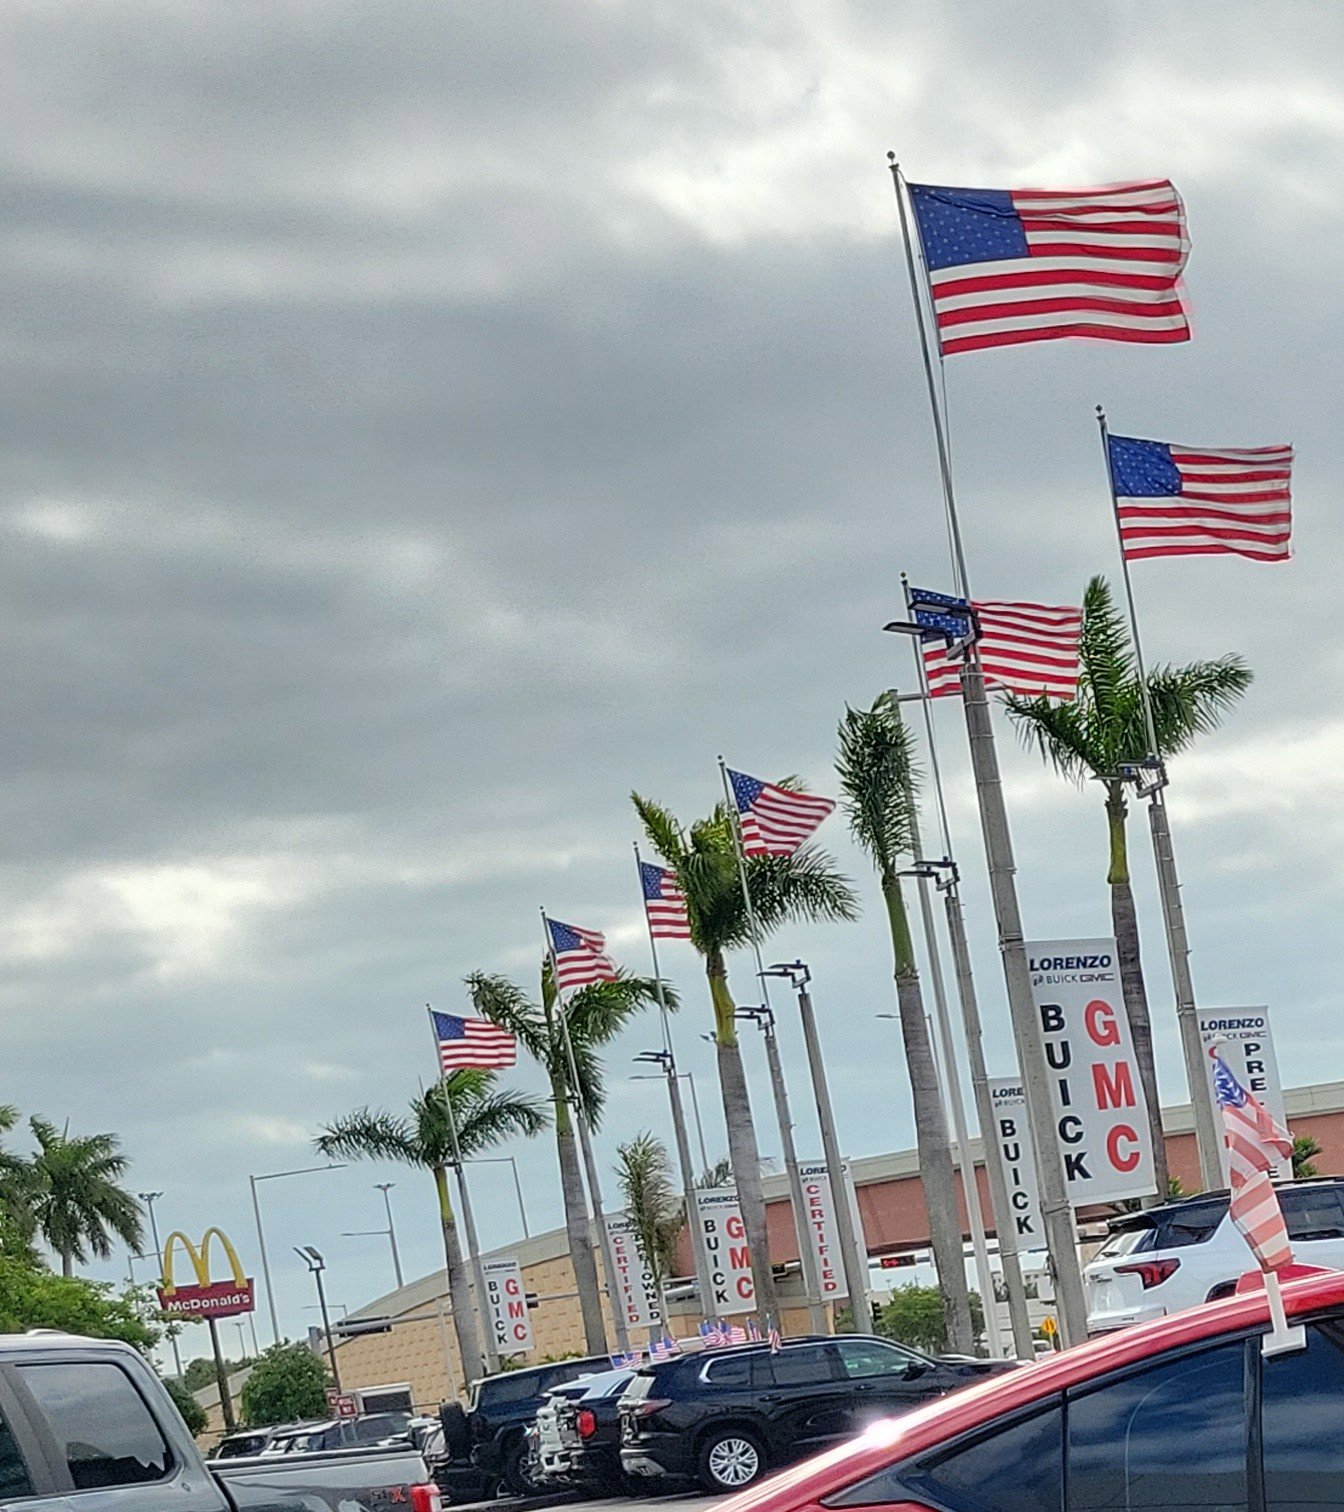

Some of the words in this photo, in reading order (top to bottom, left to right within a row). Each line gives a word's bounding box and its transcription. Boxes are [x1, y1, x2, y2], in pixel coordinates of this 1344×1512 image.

[1029, 955, 1112, 972] LORENZO
[1200, 1018, 1264, 1031] LORENZO
[992, 1087, 1024, 1098] LORE
[1039, 1003, 1092, 1181] BUICK
[1084, 999, 1141, 1173] GMC
[999, 1119, 1035, 1235] BUICK
[704, 1219, 729, 1304] BUICK
[726, 1216, 754, 1299] GMC
[806, 1184, 837, 1292] CERTIFIED
[167, 1293, 251, 1311] McDonald's
[488, 1280, 508, 1344] BUICK
[505, 1278, 528, 1341] GMC
